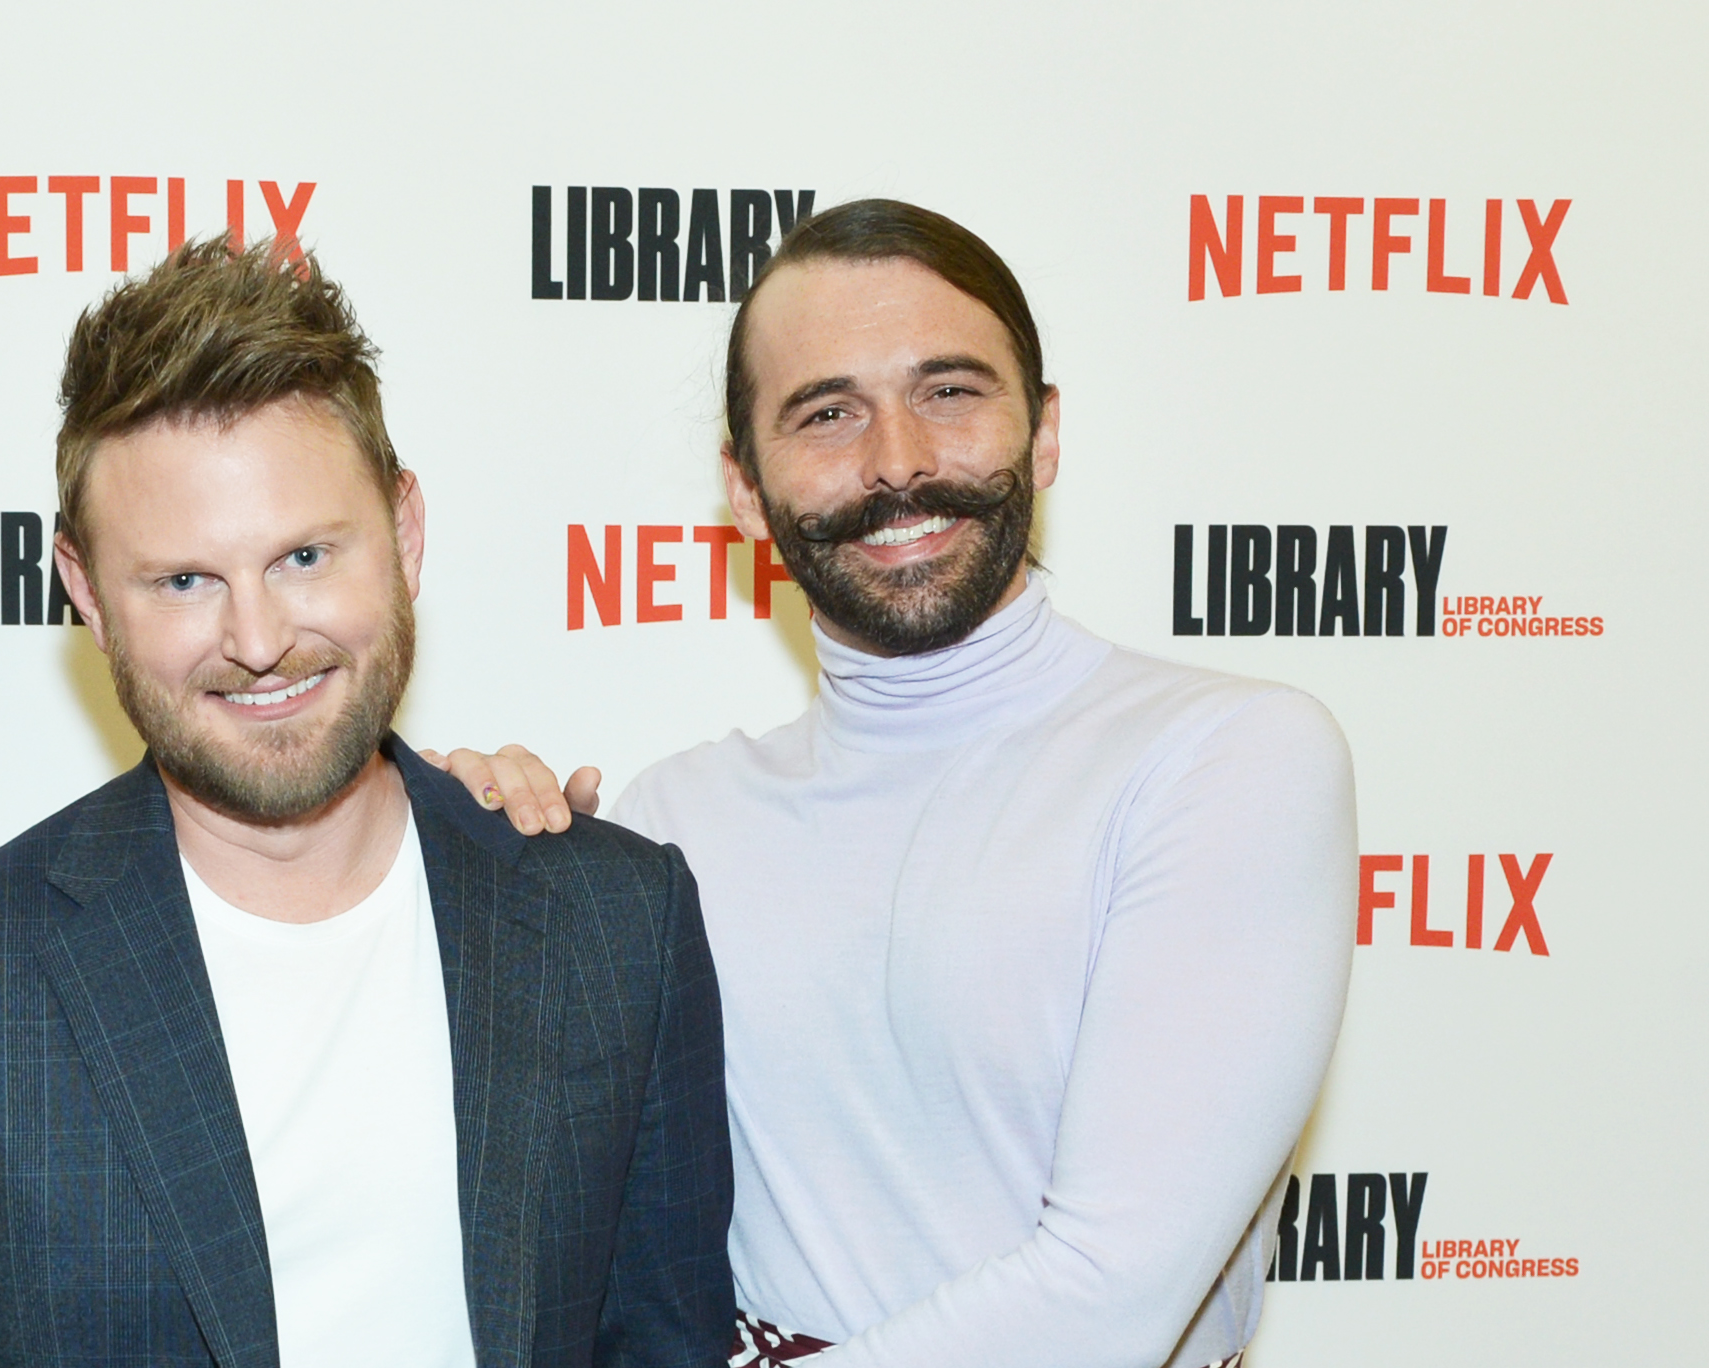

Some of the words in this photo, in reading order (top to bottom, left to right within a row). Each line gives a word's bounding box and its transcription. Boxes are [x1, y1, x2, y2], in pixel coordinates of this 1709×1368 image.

[1187, 193, 1573, 306] NETFLIX
[566, 523, 795, 632] NETF
[1172, 524, 1448, 637] LIBRARY
[1443, 596, 1543, 616] LIBRARY
[1442, 617, 1472, 637] OF
[1477, 616, 1604, 637] CONGRESS
[1355, 852, 1554, 957] FLIX
[1421, 1238, 1520, 1259] LIBRARY
[1421, 1260, 1450, 1280] OF
[1455, 1257, 1580, 1279] CONGRESS
